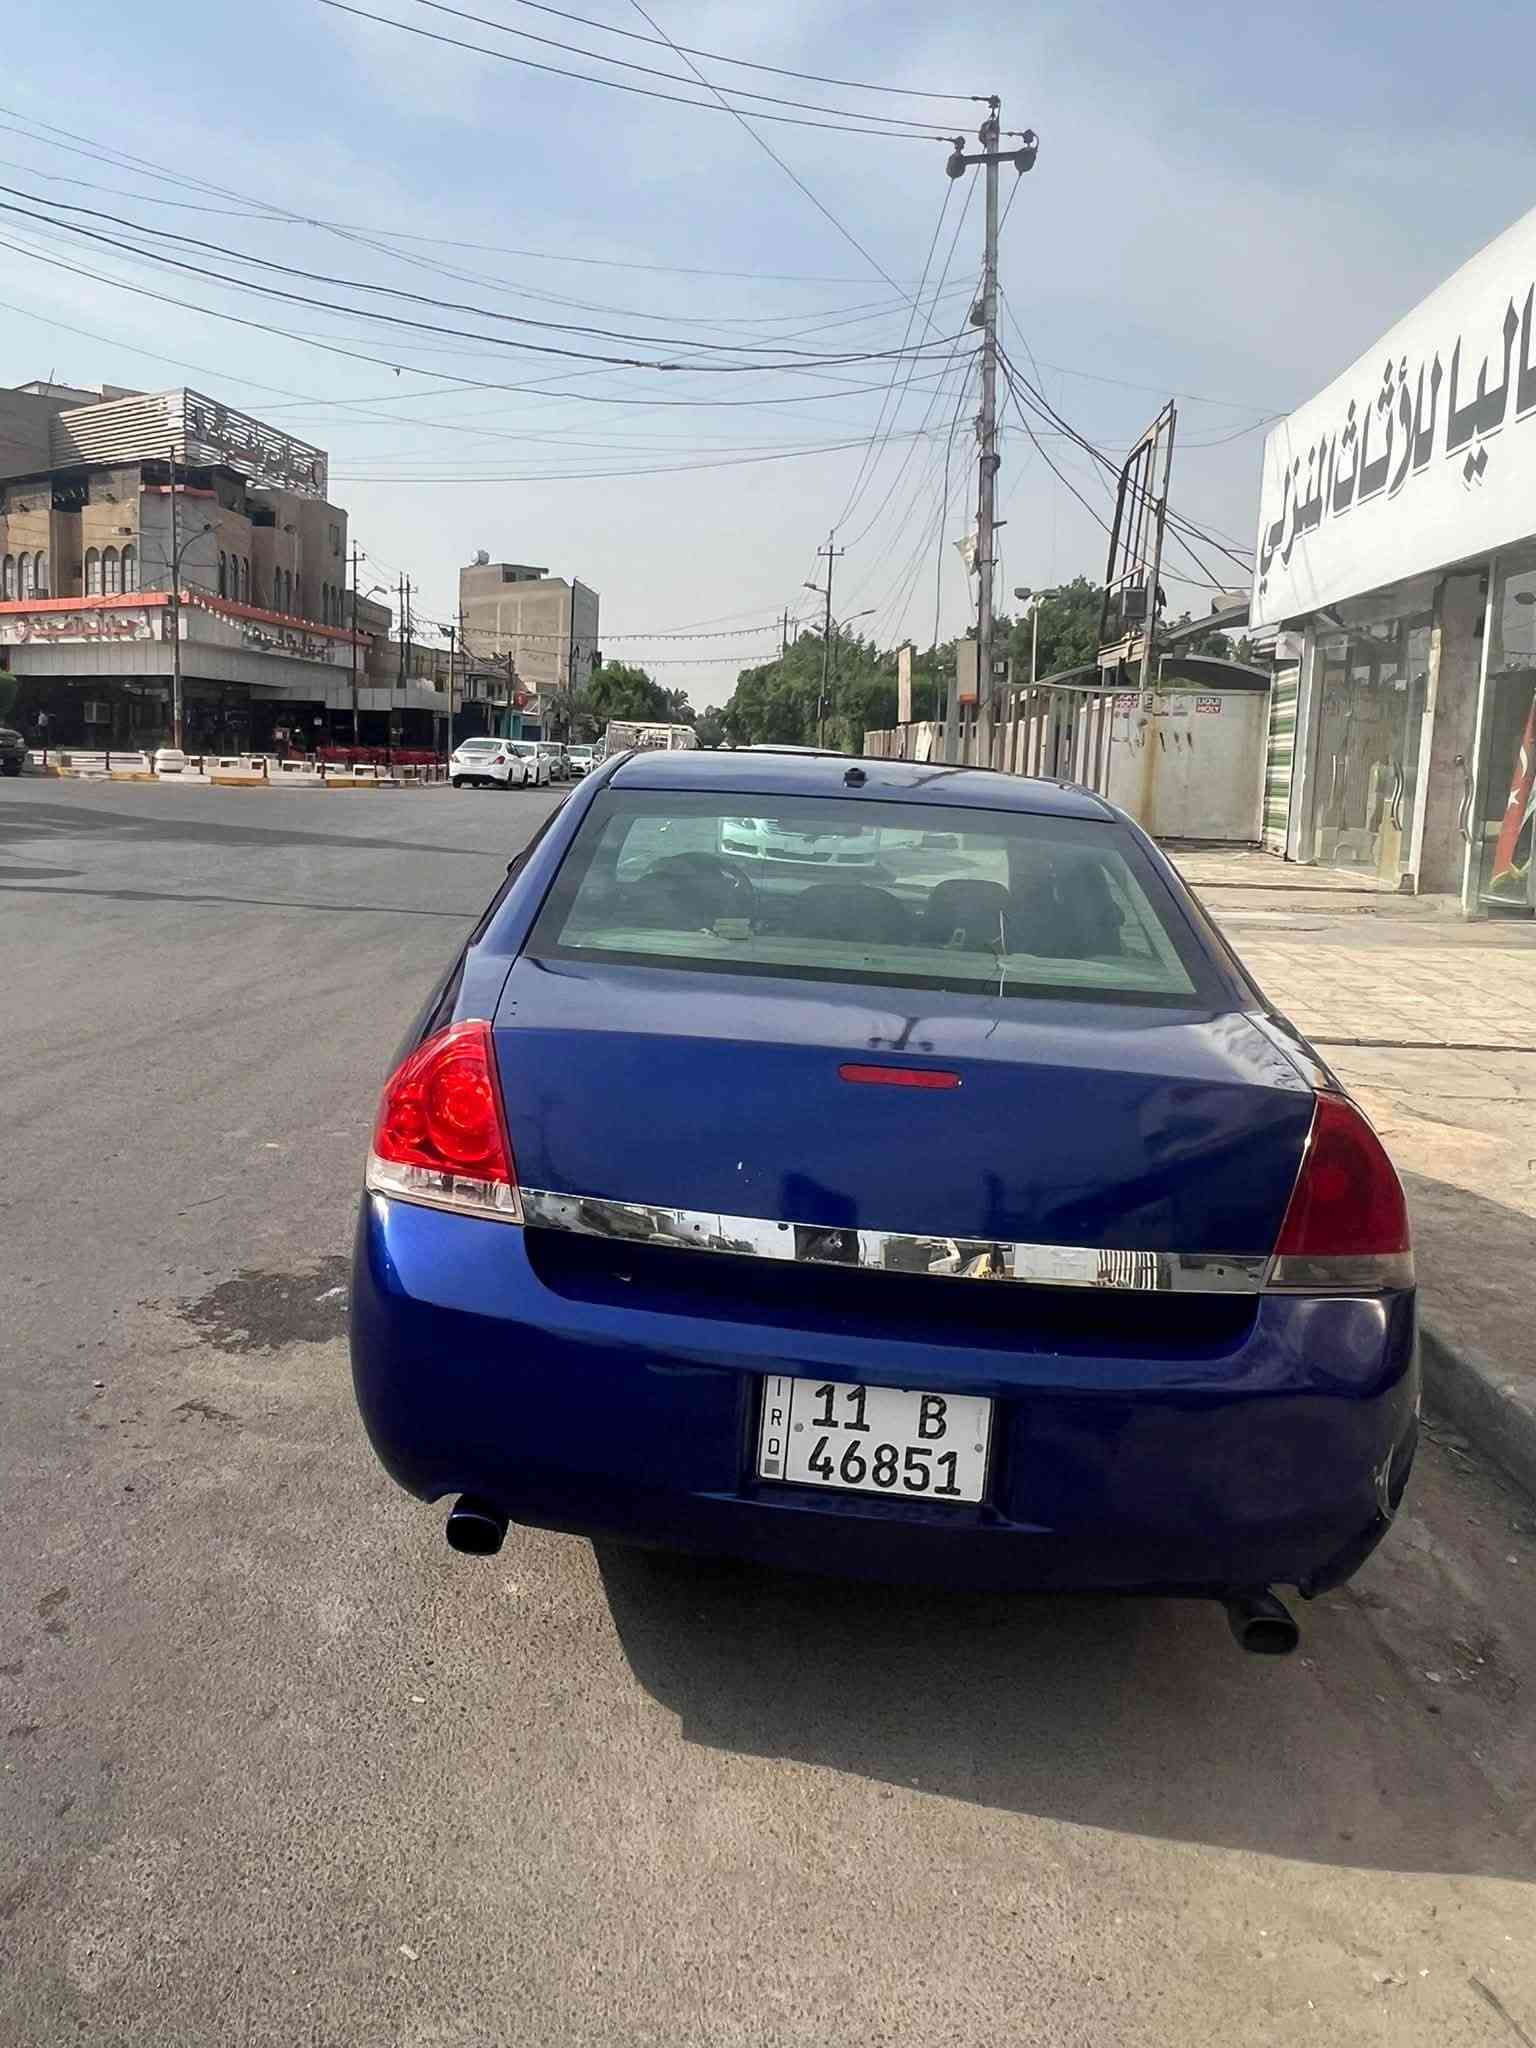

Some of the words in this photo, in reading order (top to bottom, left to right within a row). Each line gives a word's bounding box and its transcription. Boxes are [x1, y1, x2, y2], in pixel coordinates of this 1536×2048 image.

[812, 1384, 870, 1433] 11
[918, 1394, 948, 1440] B
[808, 1436, 961, 1496] 46851
